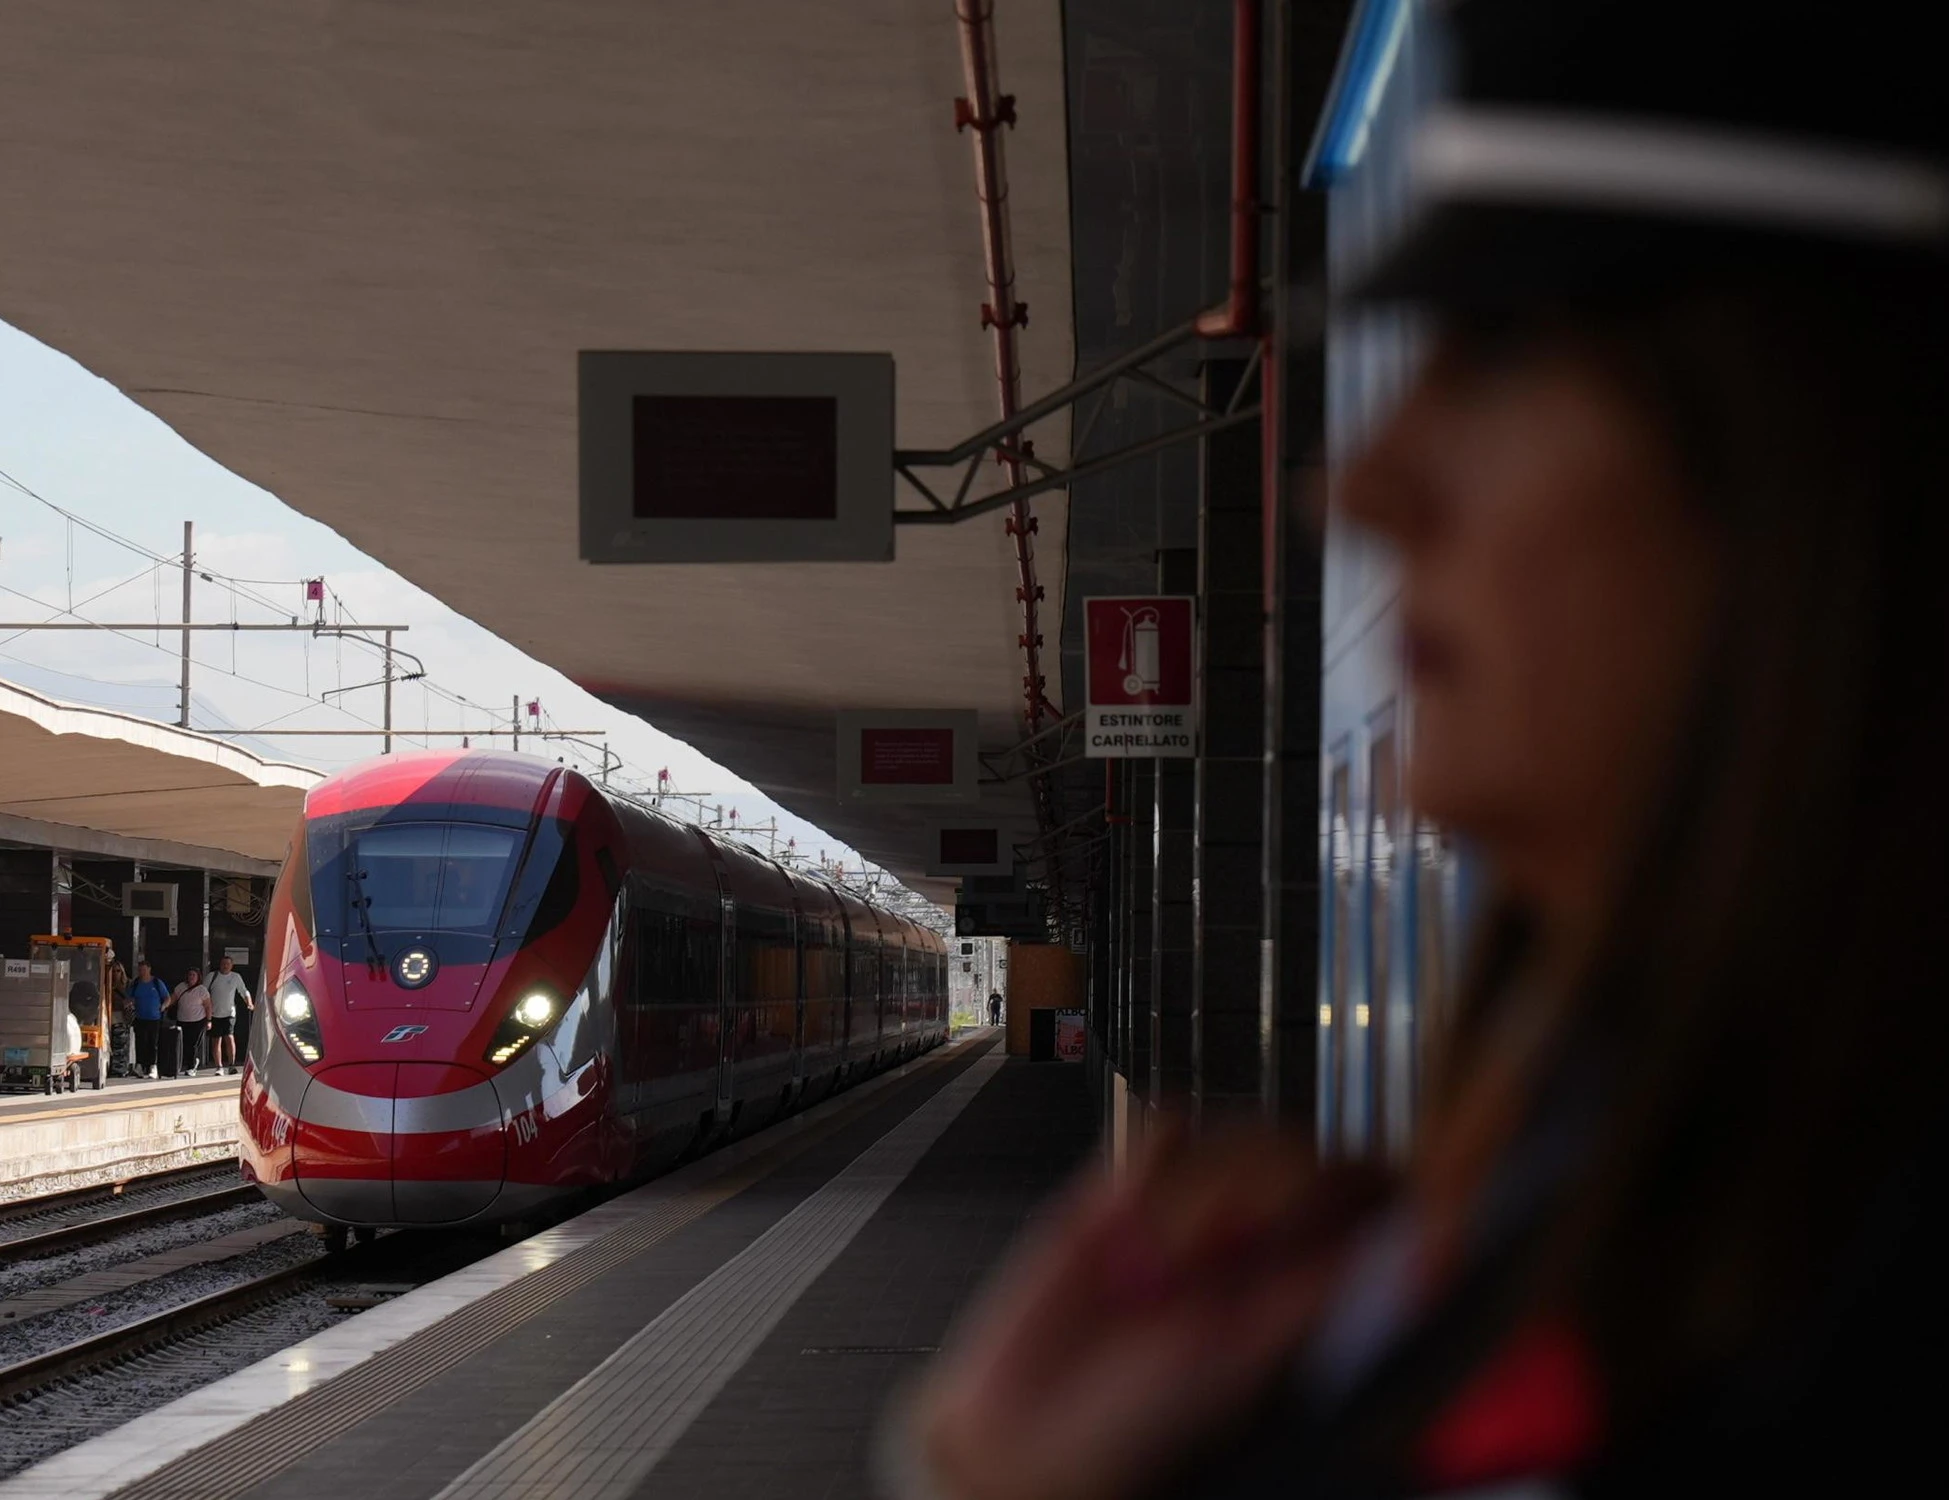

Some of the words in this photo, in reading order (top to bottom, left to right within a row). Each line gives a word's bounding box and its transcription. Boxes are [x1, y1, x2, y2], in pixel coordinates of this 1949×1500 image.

[1100, 714, 1183, 726] ESTINTORE
[1092, 734, 1189, 747] CARRELLATO
[512, 1110, 538, 1147] 104
